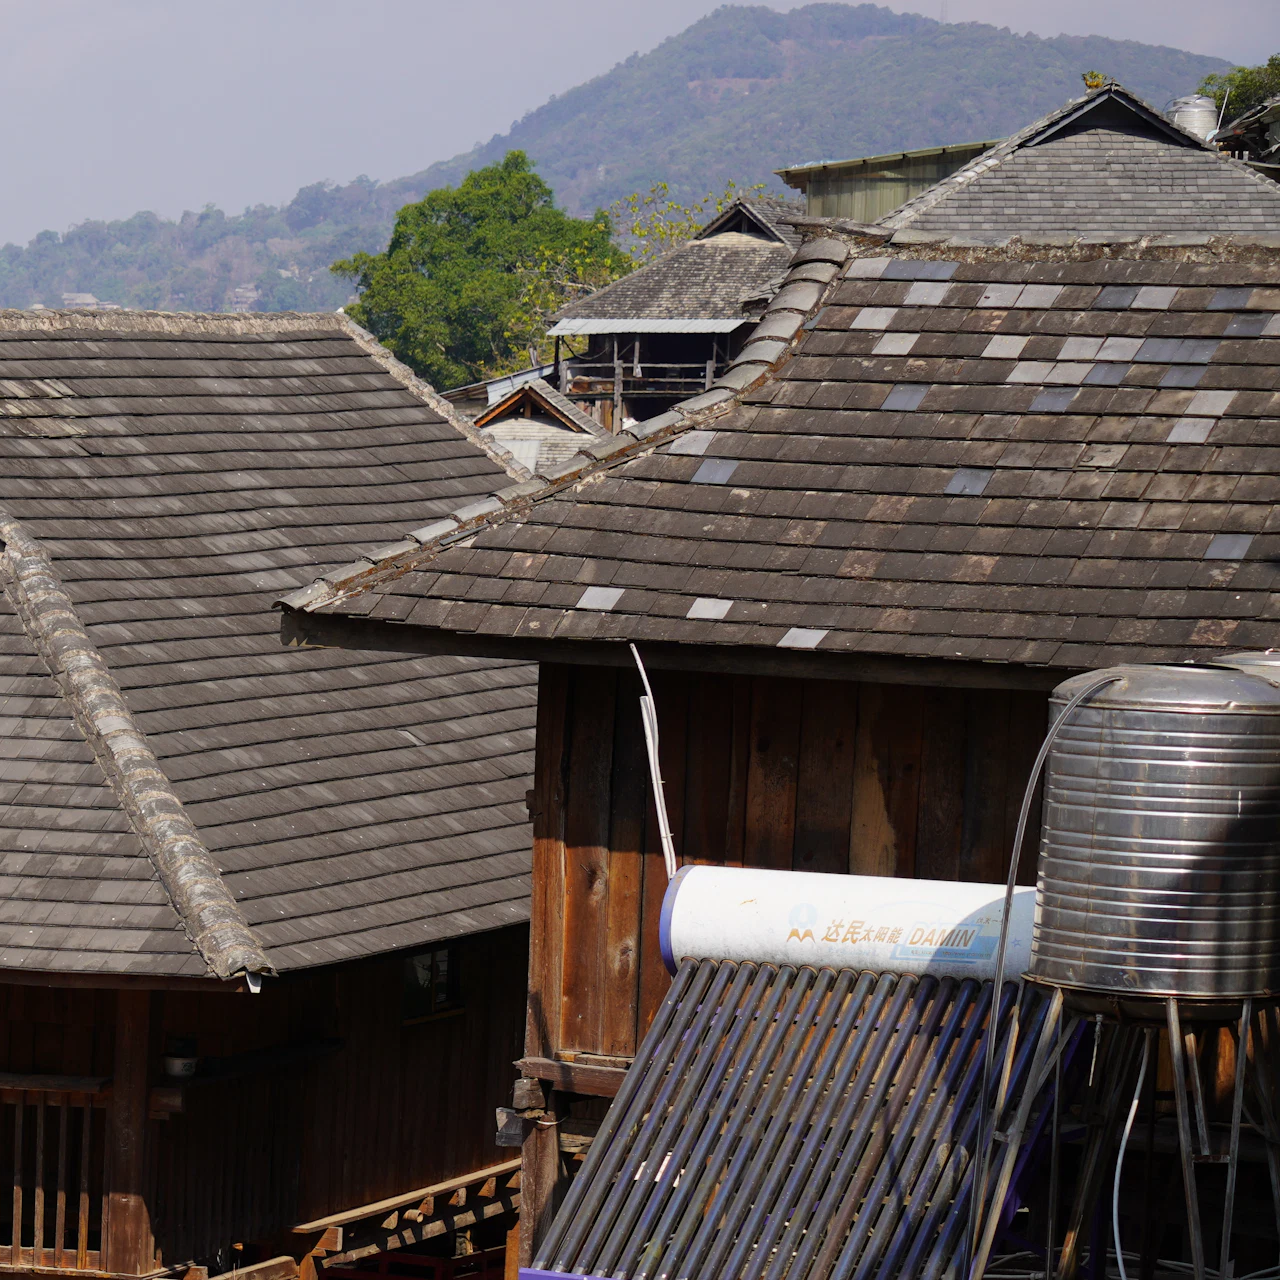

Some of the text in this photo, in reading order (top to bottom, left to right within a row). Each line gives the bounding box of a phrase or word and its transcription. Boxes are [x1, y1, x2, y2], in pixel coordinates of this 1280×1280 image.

[821, 919, 903, 944] 达民太阳能
[908, 927, 976, 947] DAMIN
